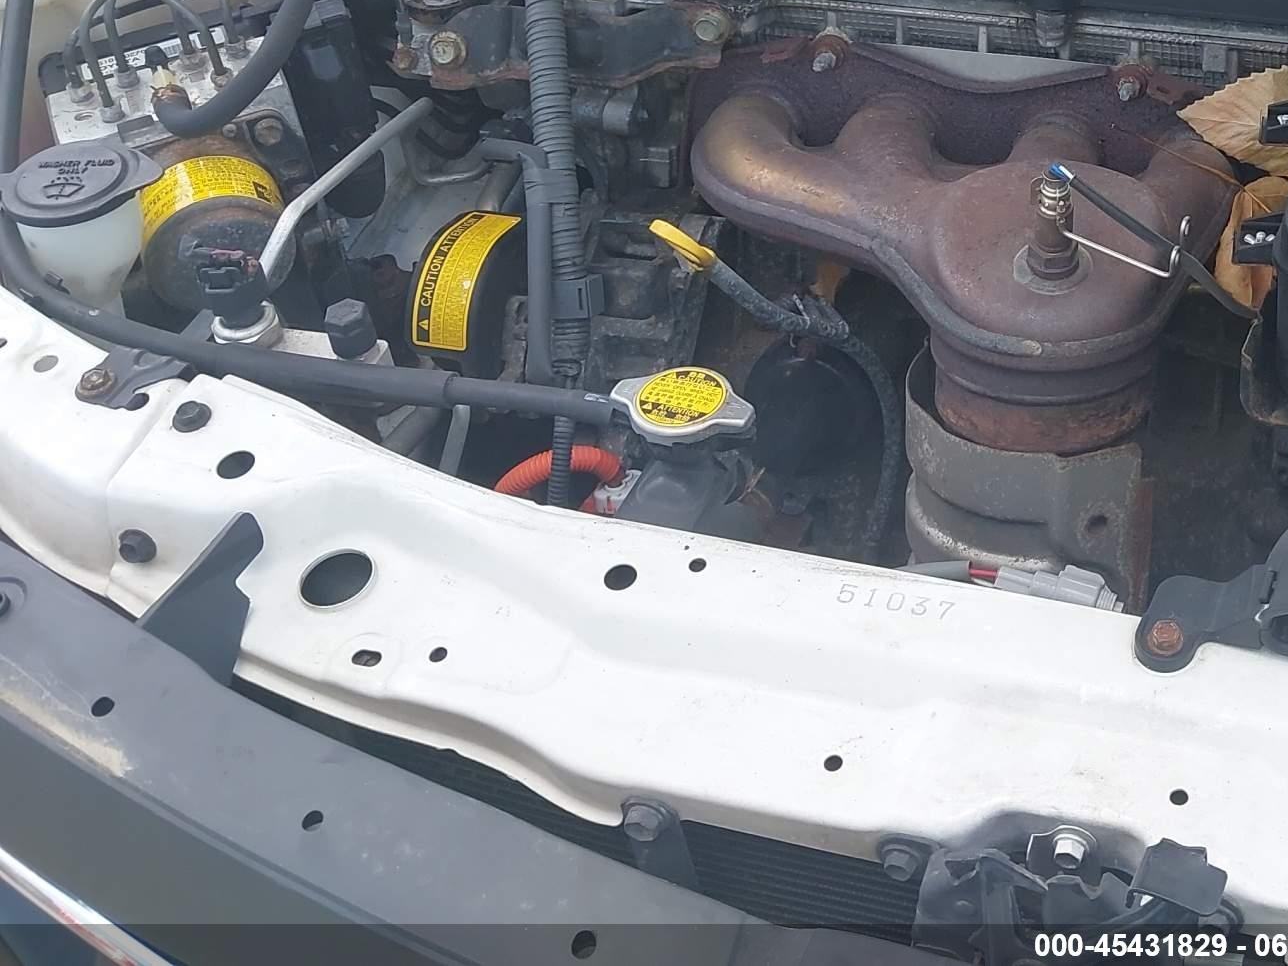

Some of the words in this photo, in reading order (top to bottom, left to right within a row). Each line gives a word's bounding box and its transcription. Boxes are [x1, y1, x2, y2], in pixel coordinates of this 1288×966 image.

[38, 160, 81, 169] WASHER
[84, 159, 116, 167] FLUID
[420, 255, 445, 307] CAUTION
[440, 216, 480, 253] ATTENTION
[677, 375, 717, 387] CAUTION
[656, 404, 700, 418] ATTENTION
[836, 583, 956, 620] 51037
